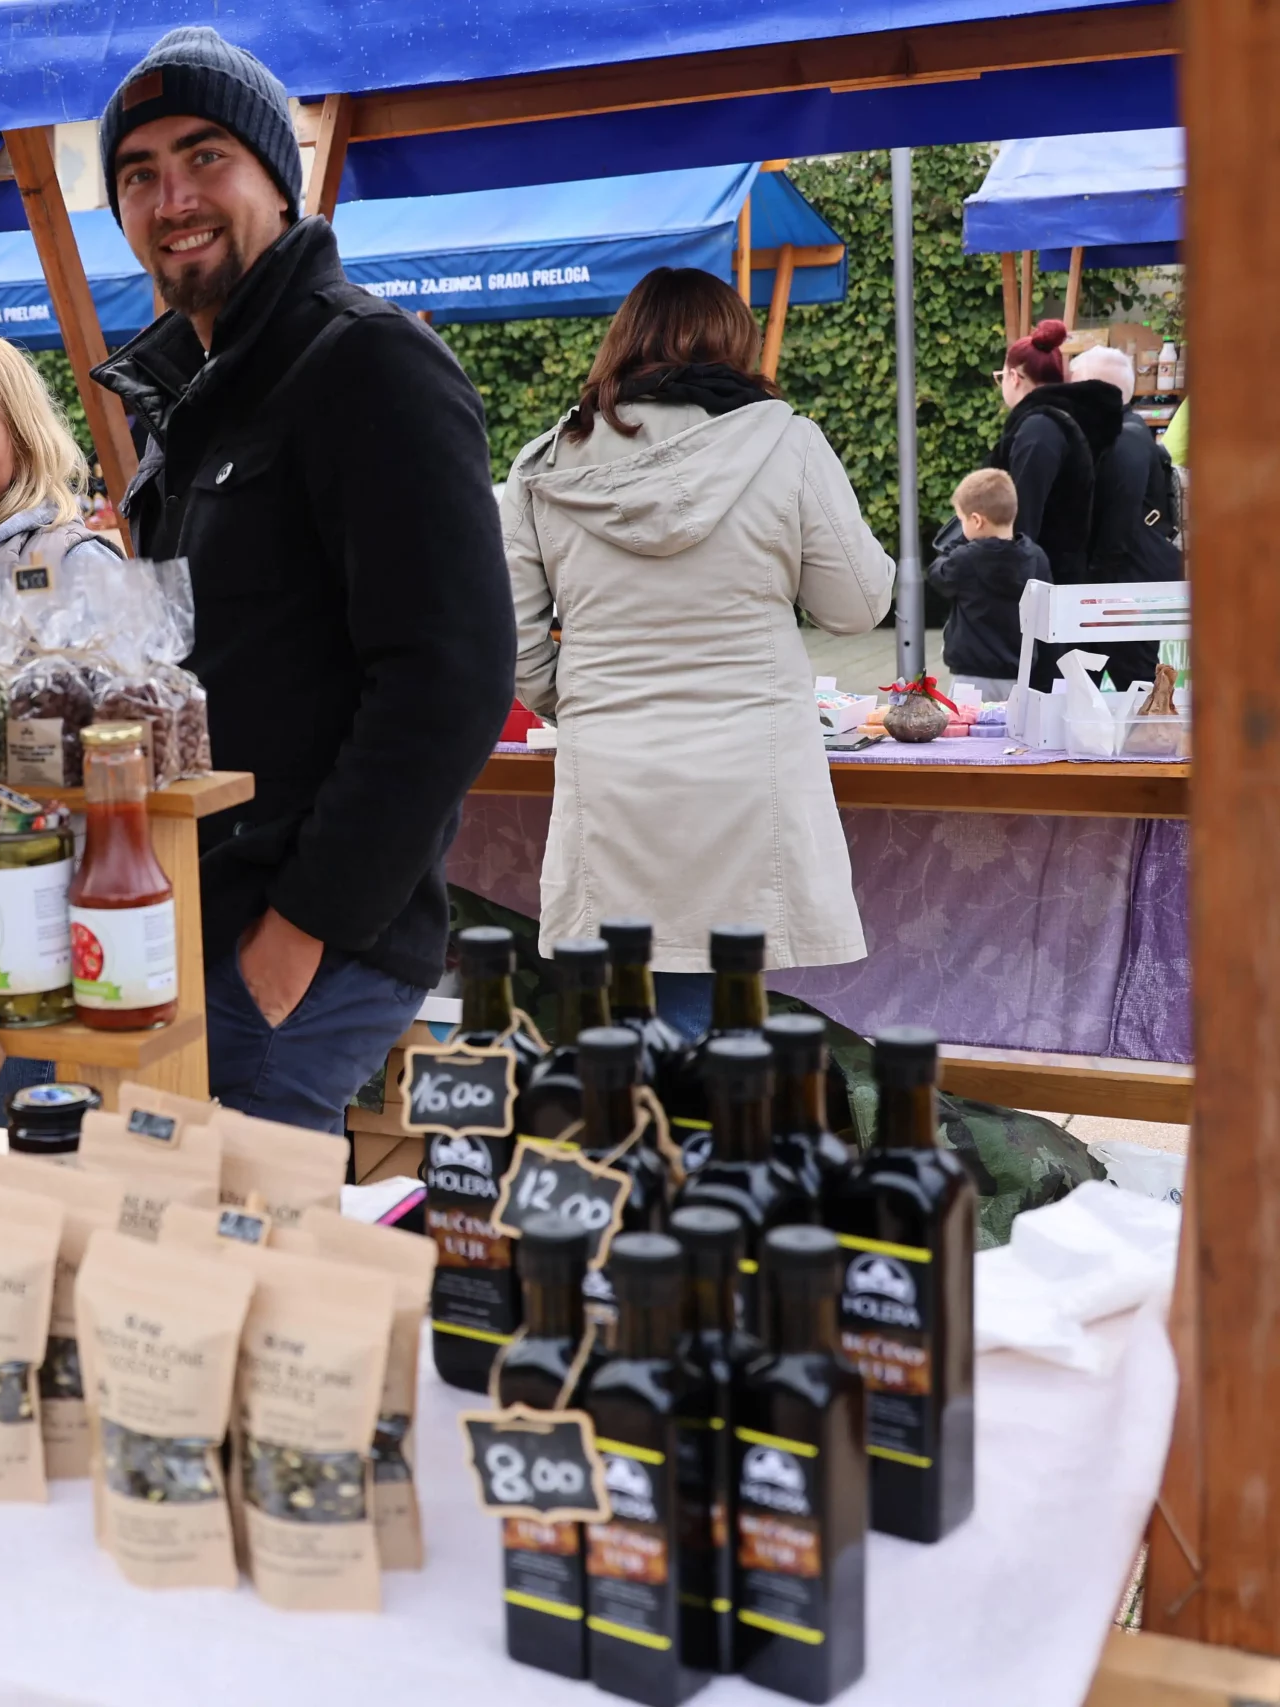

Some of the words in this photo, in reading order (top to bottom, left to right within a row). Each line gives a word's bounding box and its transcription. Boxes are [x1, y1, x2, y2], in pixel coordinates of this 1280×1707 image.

[421, 276, 482, 295] ZAJEDNICA
[488, 272, 529, 290] GRADA
[532, 266, 590, 287] PRELOGA
[4, 304, 50, 323] PRELOGA
[428, 1170, 499, 1200] HOLERA
